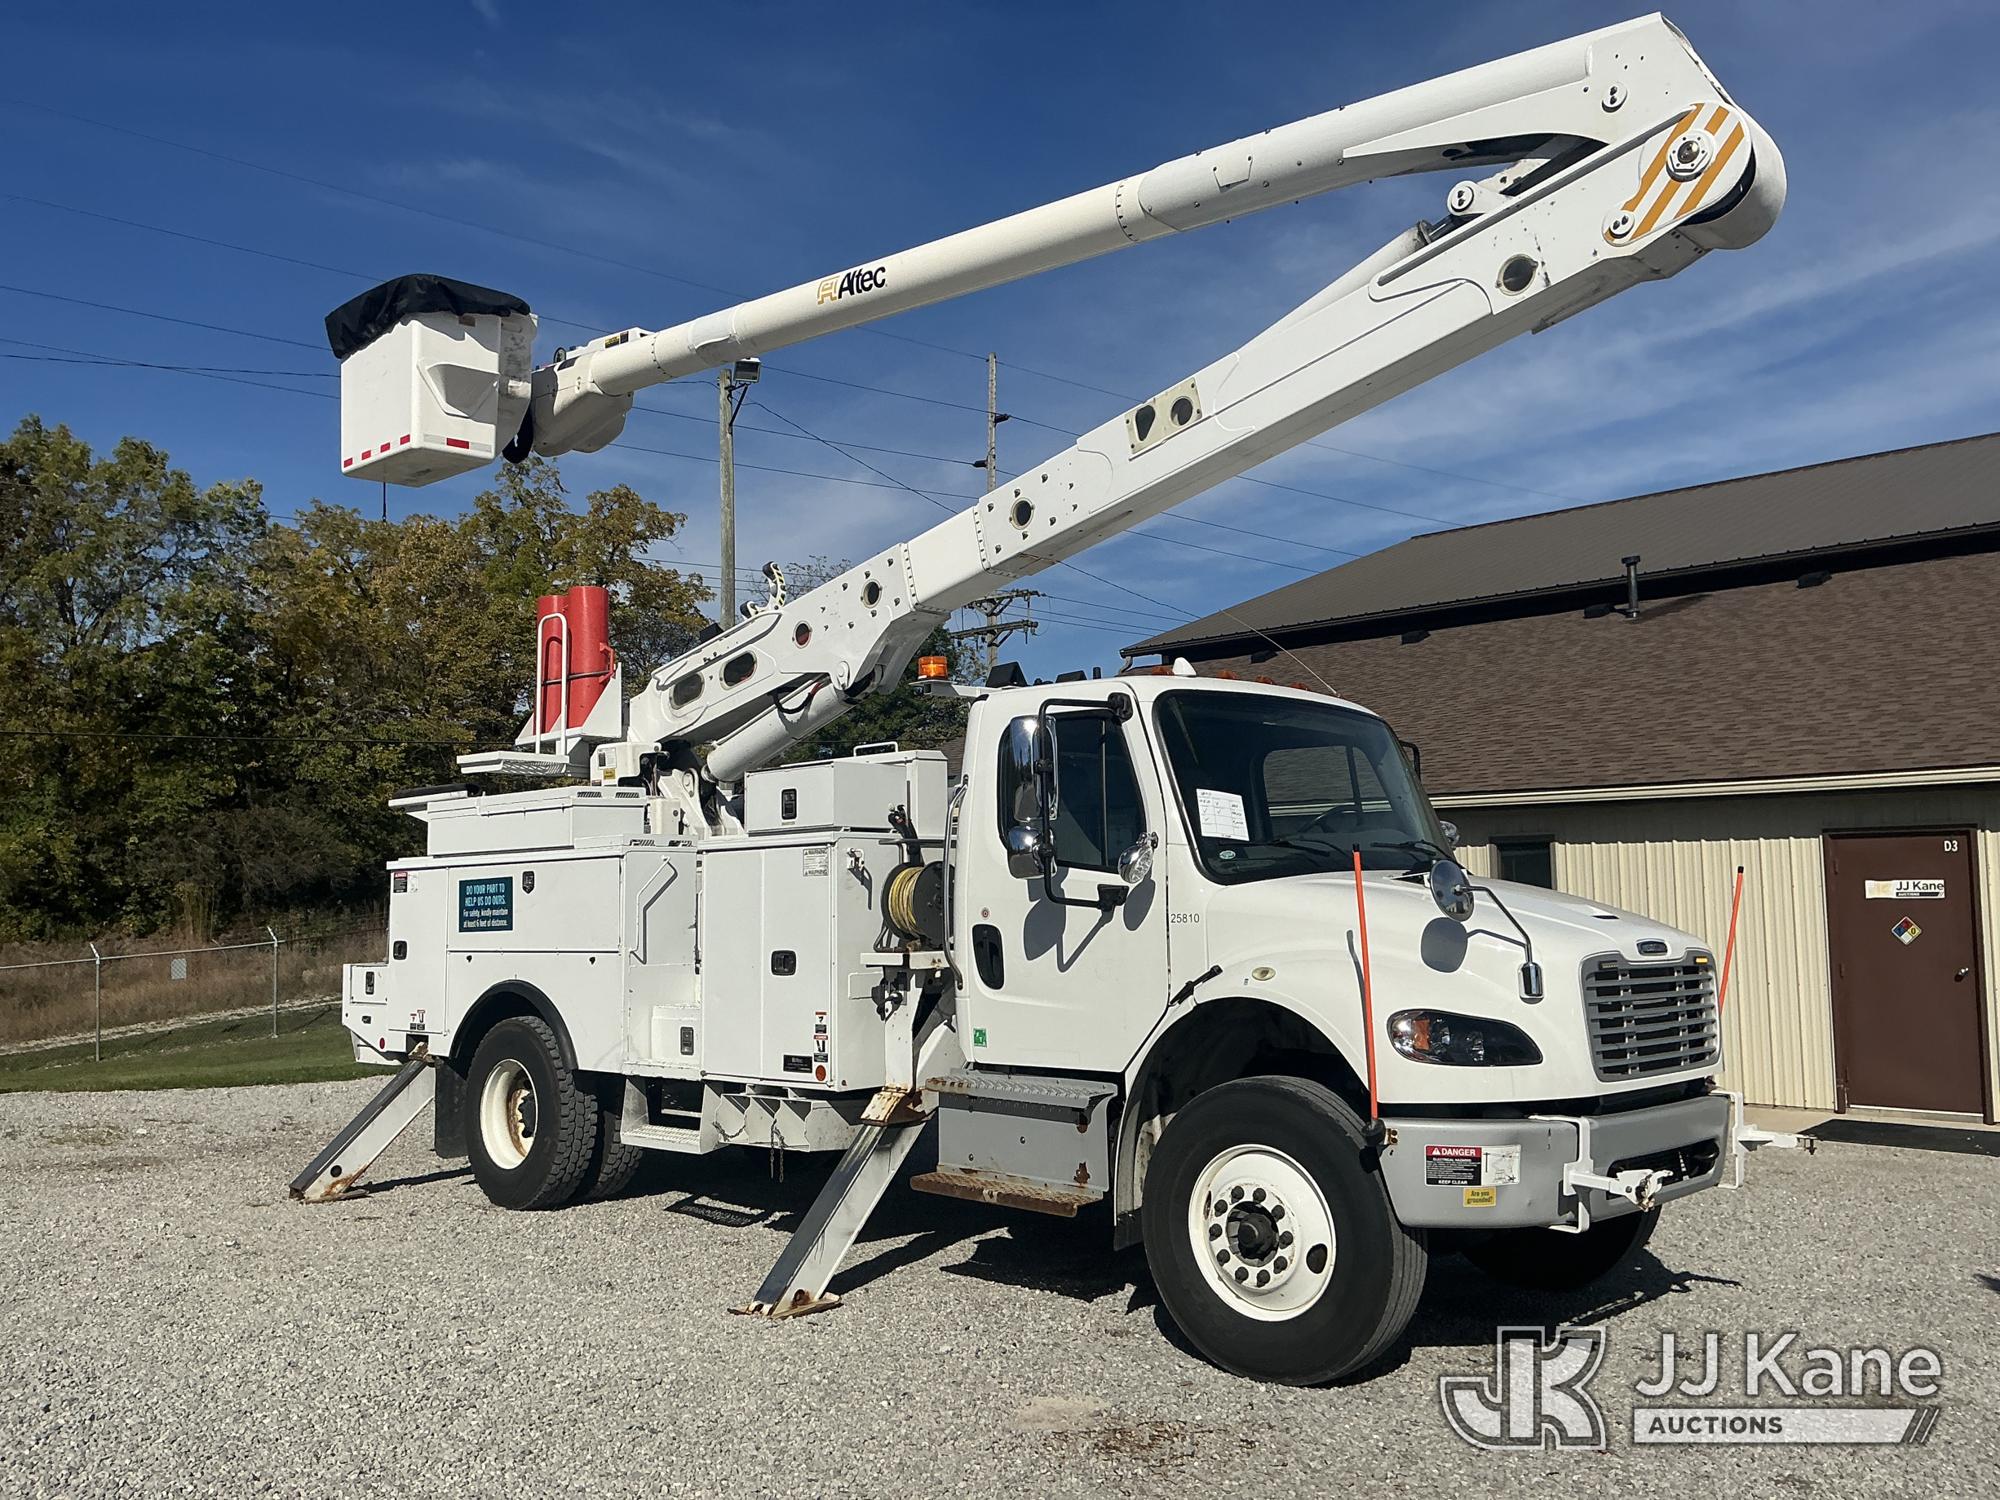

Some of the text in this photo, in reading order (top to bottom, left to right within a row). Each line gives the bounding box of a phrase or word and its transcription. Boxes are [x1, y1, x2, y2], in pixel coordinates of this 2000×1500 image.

[838, 266, 886, 299] Altec
[1943, 840, 1959, 852] D3
[1896, 881, 1945, 891] JJ Kane
[1170, 913, 1200, 923] 25810
[1441, 1147, 1476, 1156] DANGER
